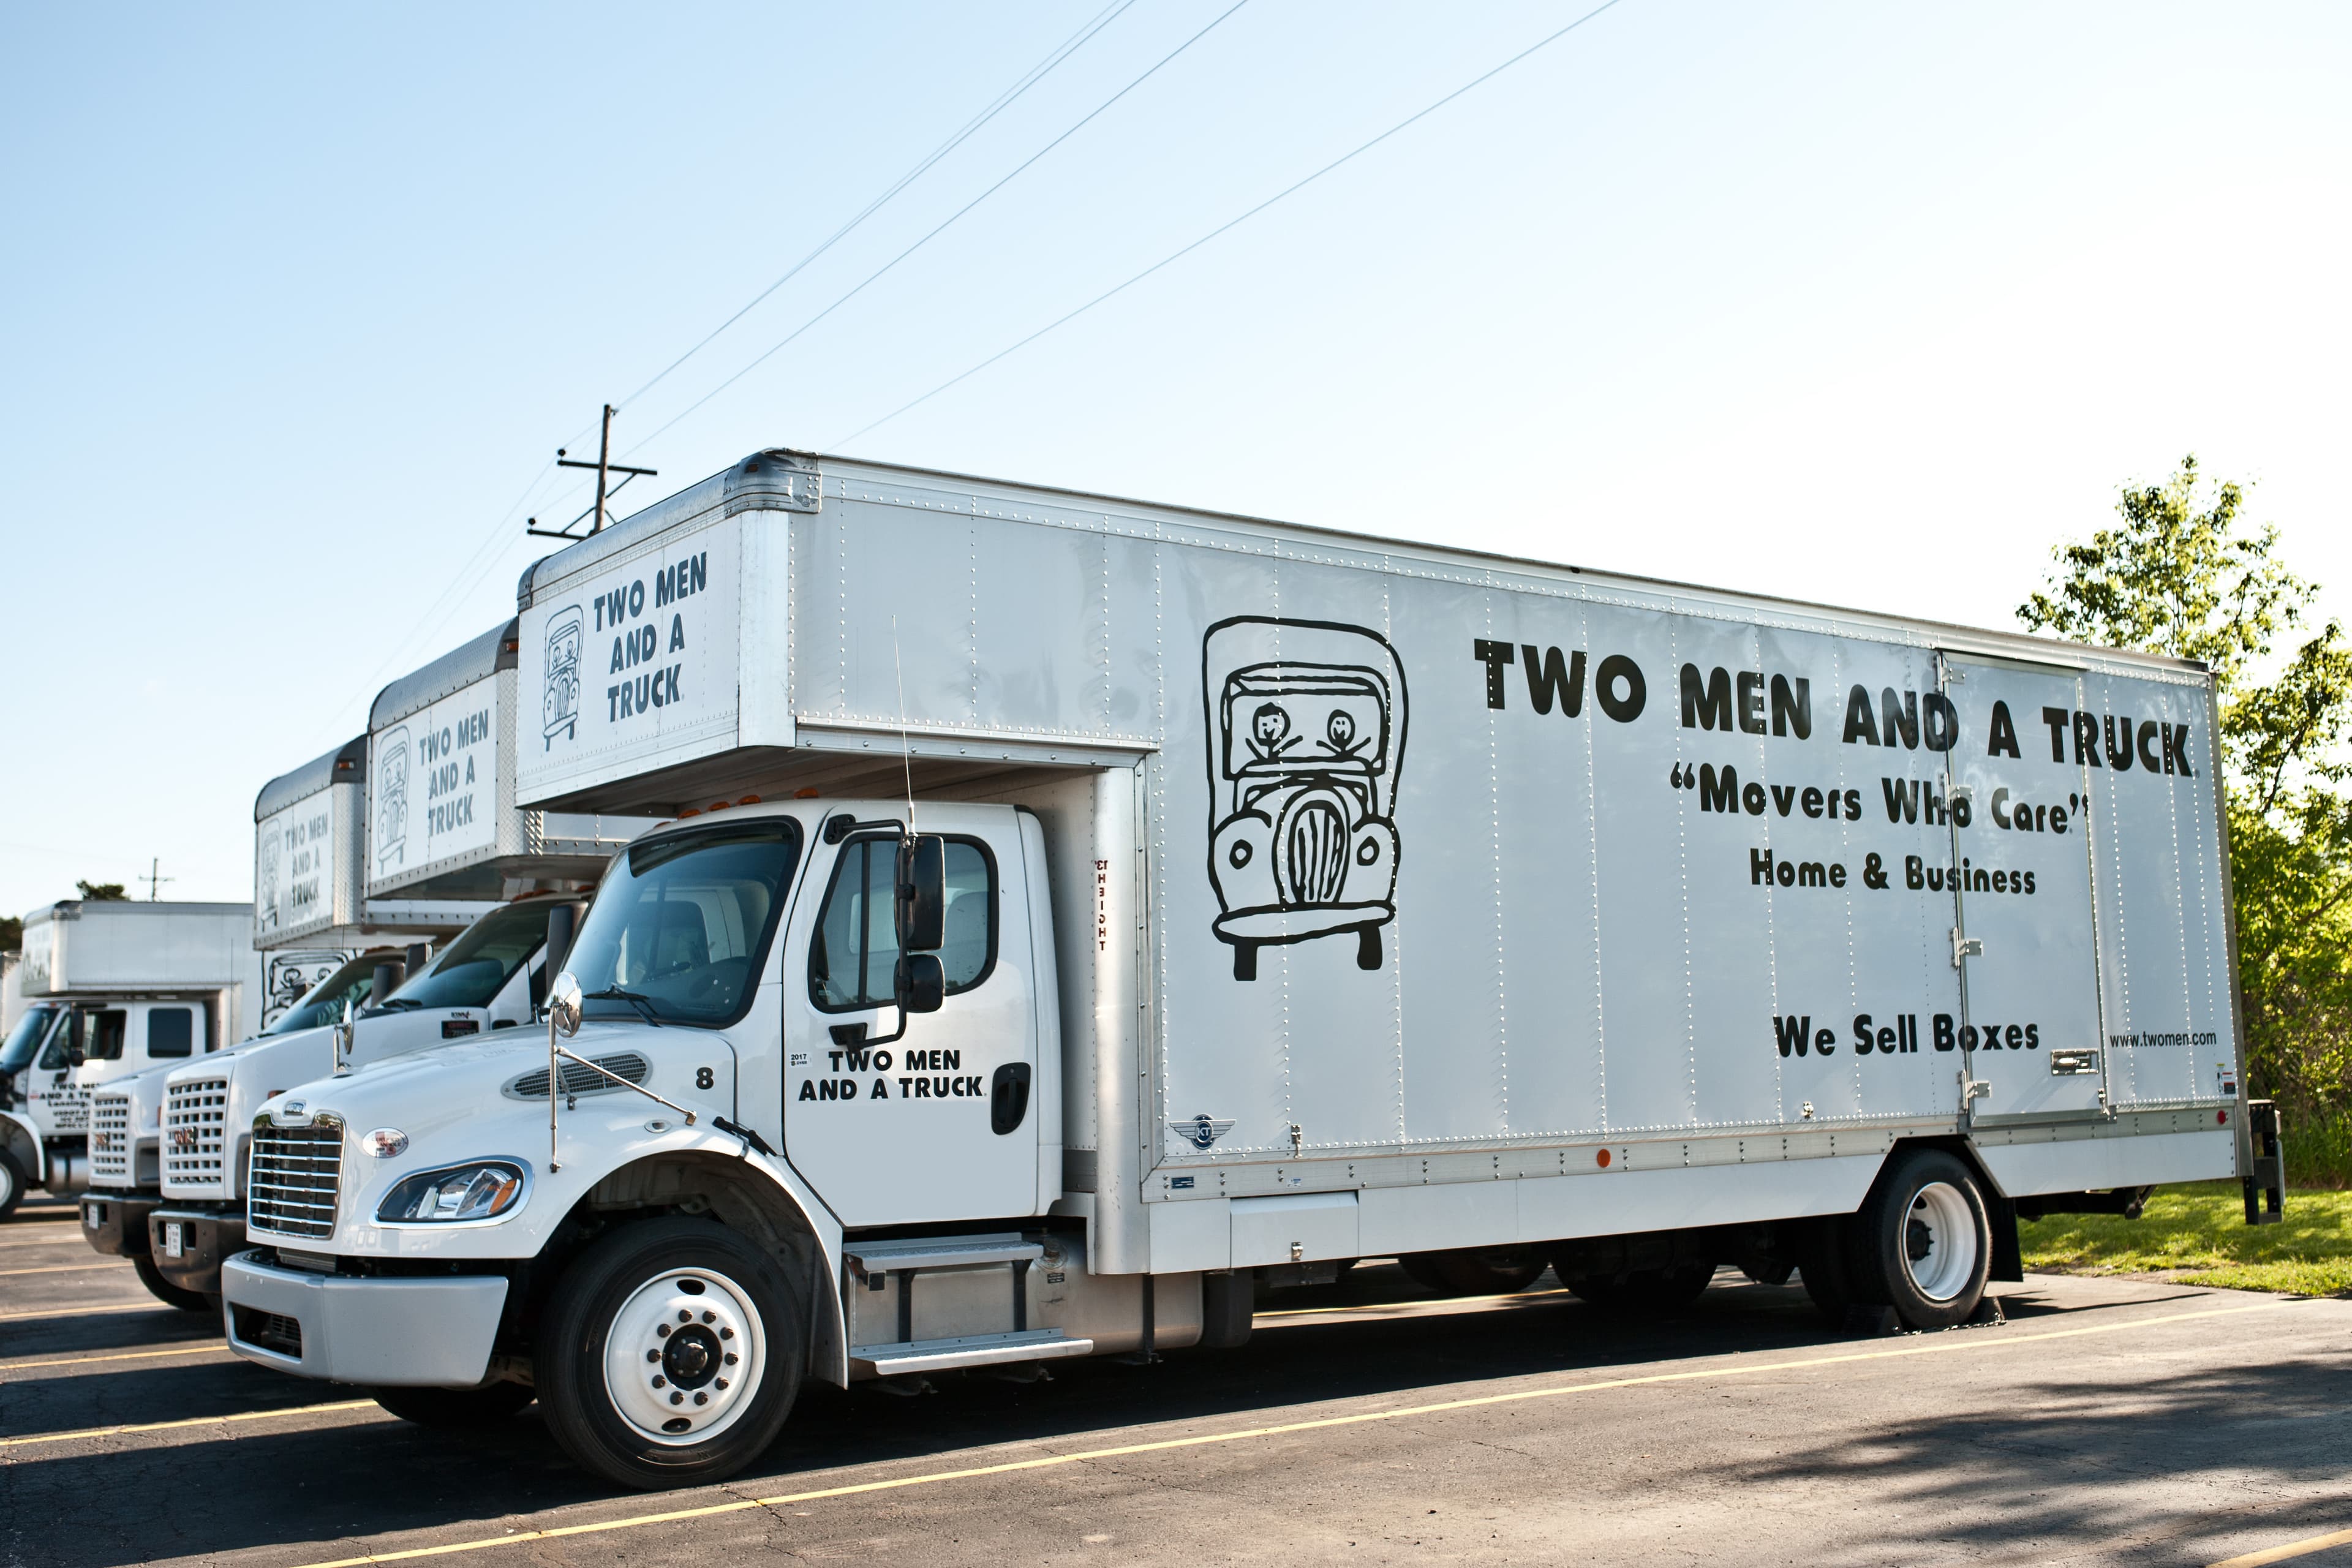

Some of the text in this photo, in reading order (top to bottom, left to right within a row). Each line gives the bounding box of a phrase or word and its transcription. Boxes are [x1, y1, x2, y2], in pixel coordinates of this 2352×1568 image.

[594, 551, 707, 633] TWO MEN
[609, 613, 685, 675] AND A
[608, 663, 682, 723] TRUCK
[1474, 638, 2192, 778] TWO MEN AND A TRUCK
[419, 709, 489, 766] TWO MEN
[429, 755, 475, 800] AND A
[429, 794, 473, 837] TRUCK
[1881, 777, 1972, 829] Who
[285, 813, 328, 851] TWO MEN
[293, 845, 320, 879] AND A
[1750, 848, 2036, 895] Home & Business
[293, 877, 319, 907] TRUCK
[1773, 1013, 2040, 1058] We Sell Boxes
[2109, 1031, 2217, 1048] www.twomen.com
[695, 1066, 714, 1090] 8
[828, 1049, 960, 1072] TWO MEN
[798, 1076, 983, 1101] AND A TRUCK
[1197, 1127, 1211, 1137] KT
